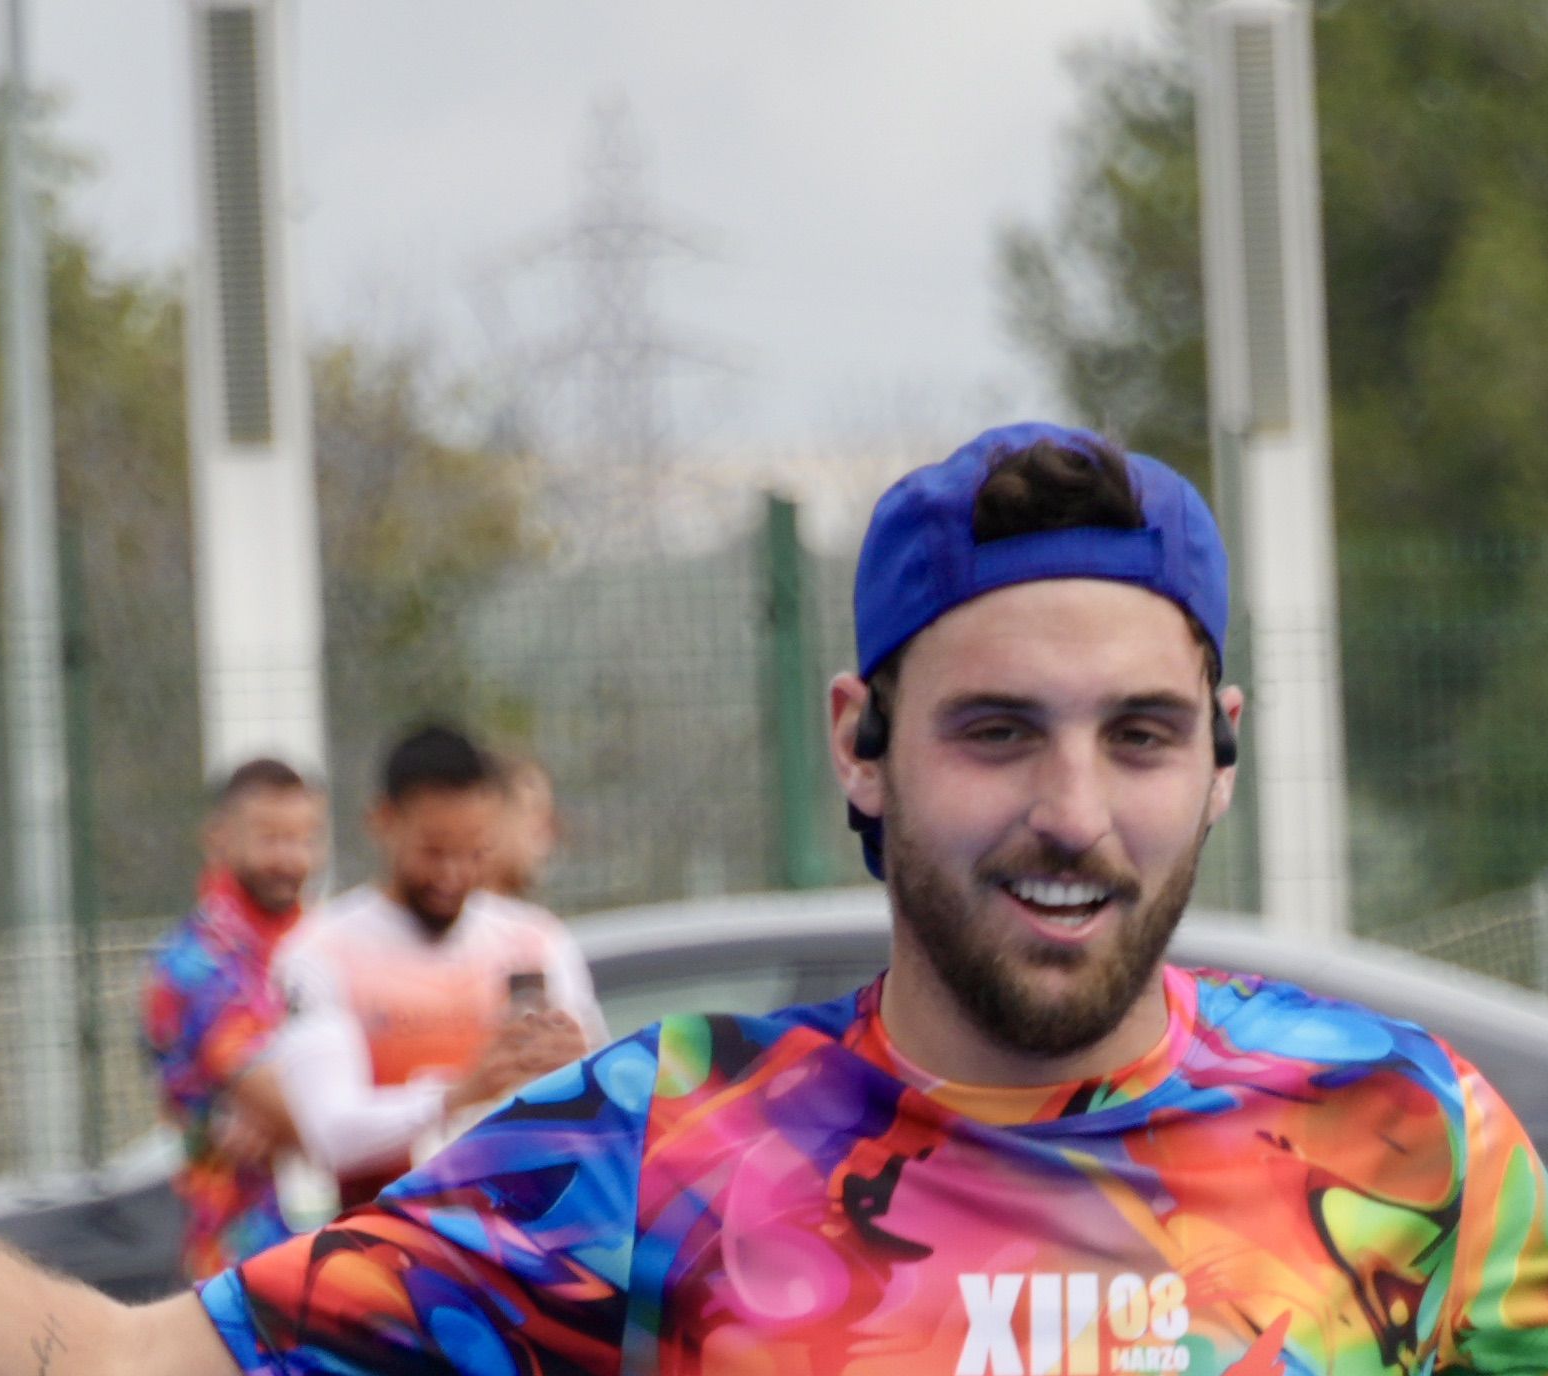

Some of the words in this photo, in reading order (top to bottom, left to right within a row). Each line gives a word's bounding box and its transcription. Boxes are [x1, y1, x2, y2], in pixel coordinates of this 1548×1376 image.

[954, 1272, 1100, 1376] XII
[1108, 1272, 1190, 1341] 08
[1110, 1345, 1190, 1372] MARZO
